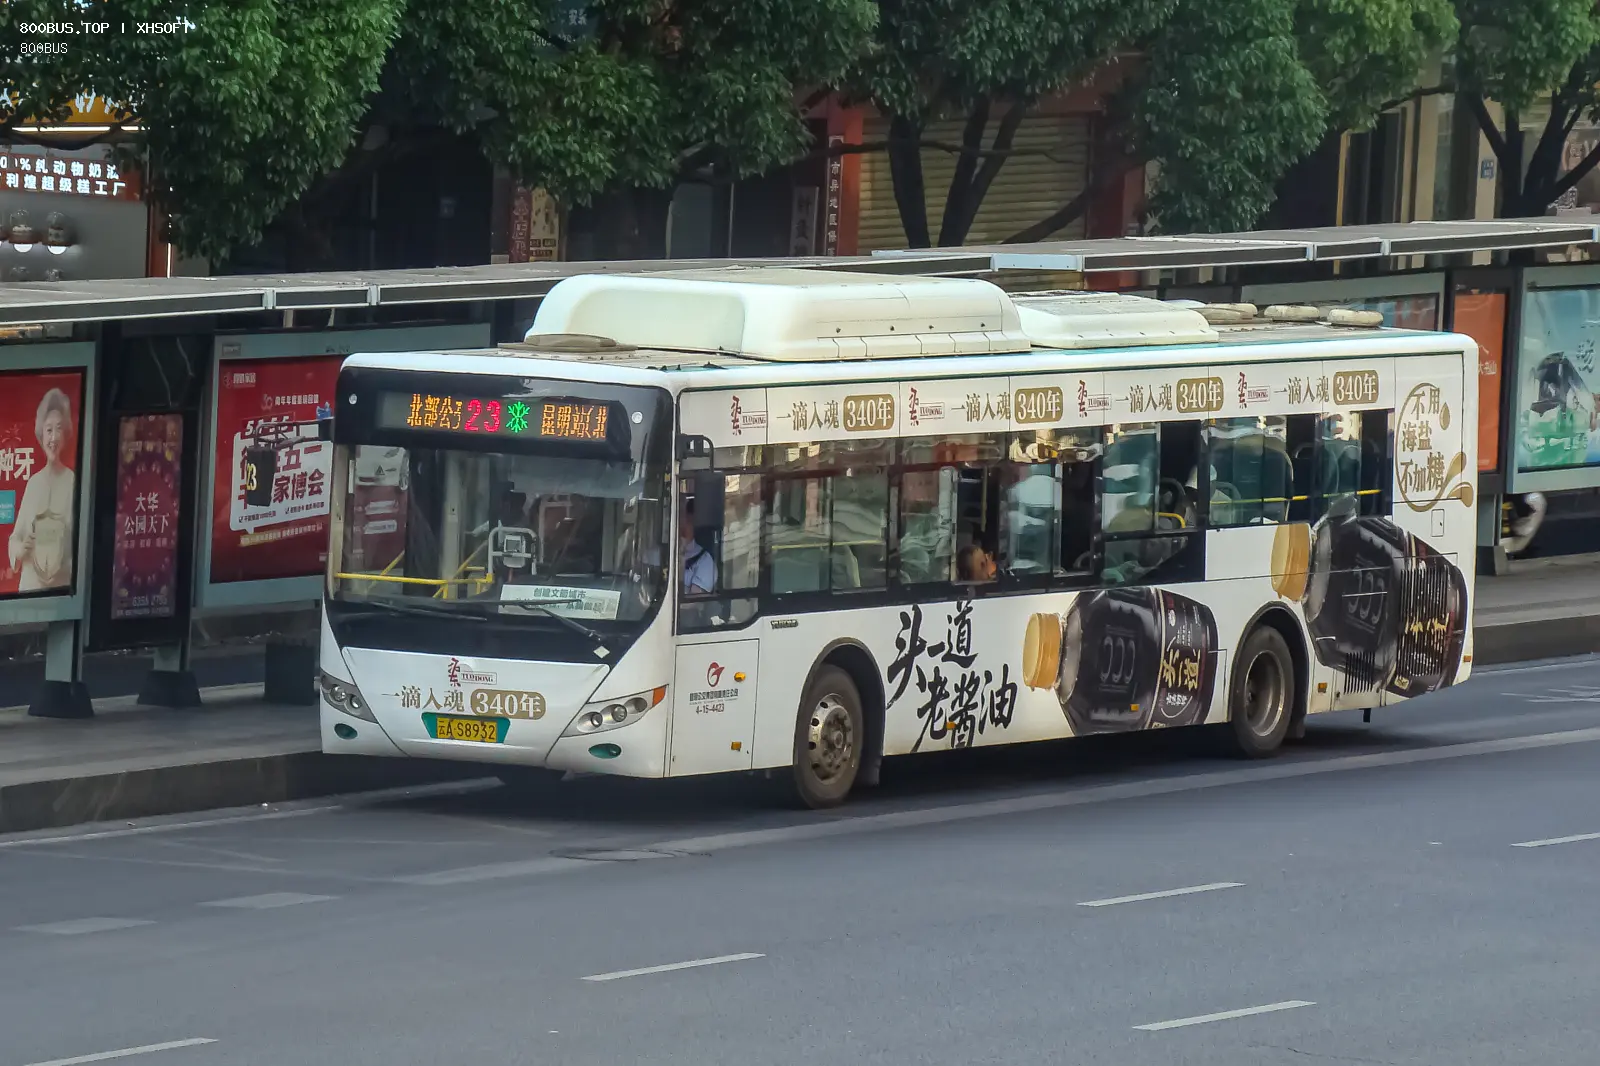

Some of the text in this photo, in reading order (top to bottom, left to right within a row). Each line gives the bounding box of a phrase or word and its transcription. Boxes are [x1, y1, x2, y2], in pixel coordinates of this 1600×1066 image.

[1115, 379, 1222, 413] 一滴人魂 340年
[1274, 372, 1378, 405] 一滴人魂 340年
[1410, 387, 1441, 420] 不用
[464, 398, 502, 433] 23
[776, 398, 892, 431] 一滴人魂 340年
[950, 390, 1062, 423] 一滴人魂 340年
[1401, 420, 1433, 452] 海盐
[1400, 451, 1446, 494] 不加糖
[886, 600, 979, 710] 头一道
[381, 686, 542, 718] 一滴人魂 340年
[910, 664, 1018, 753] 老酱油
